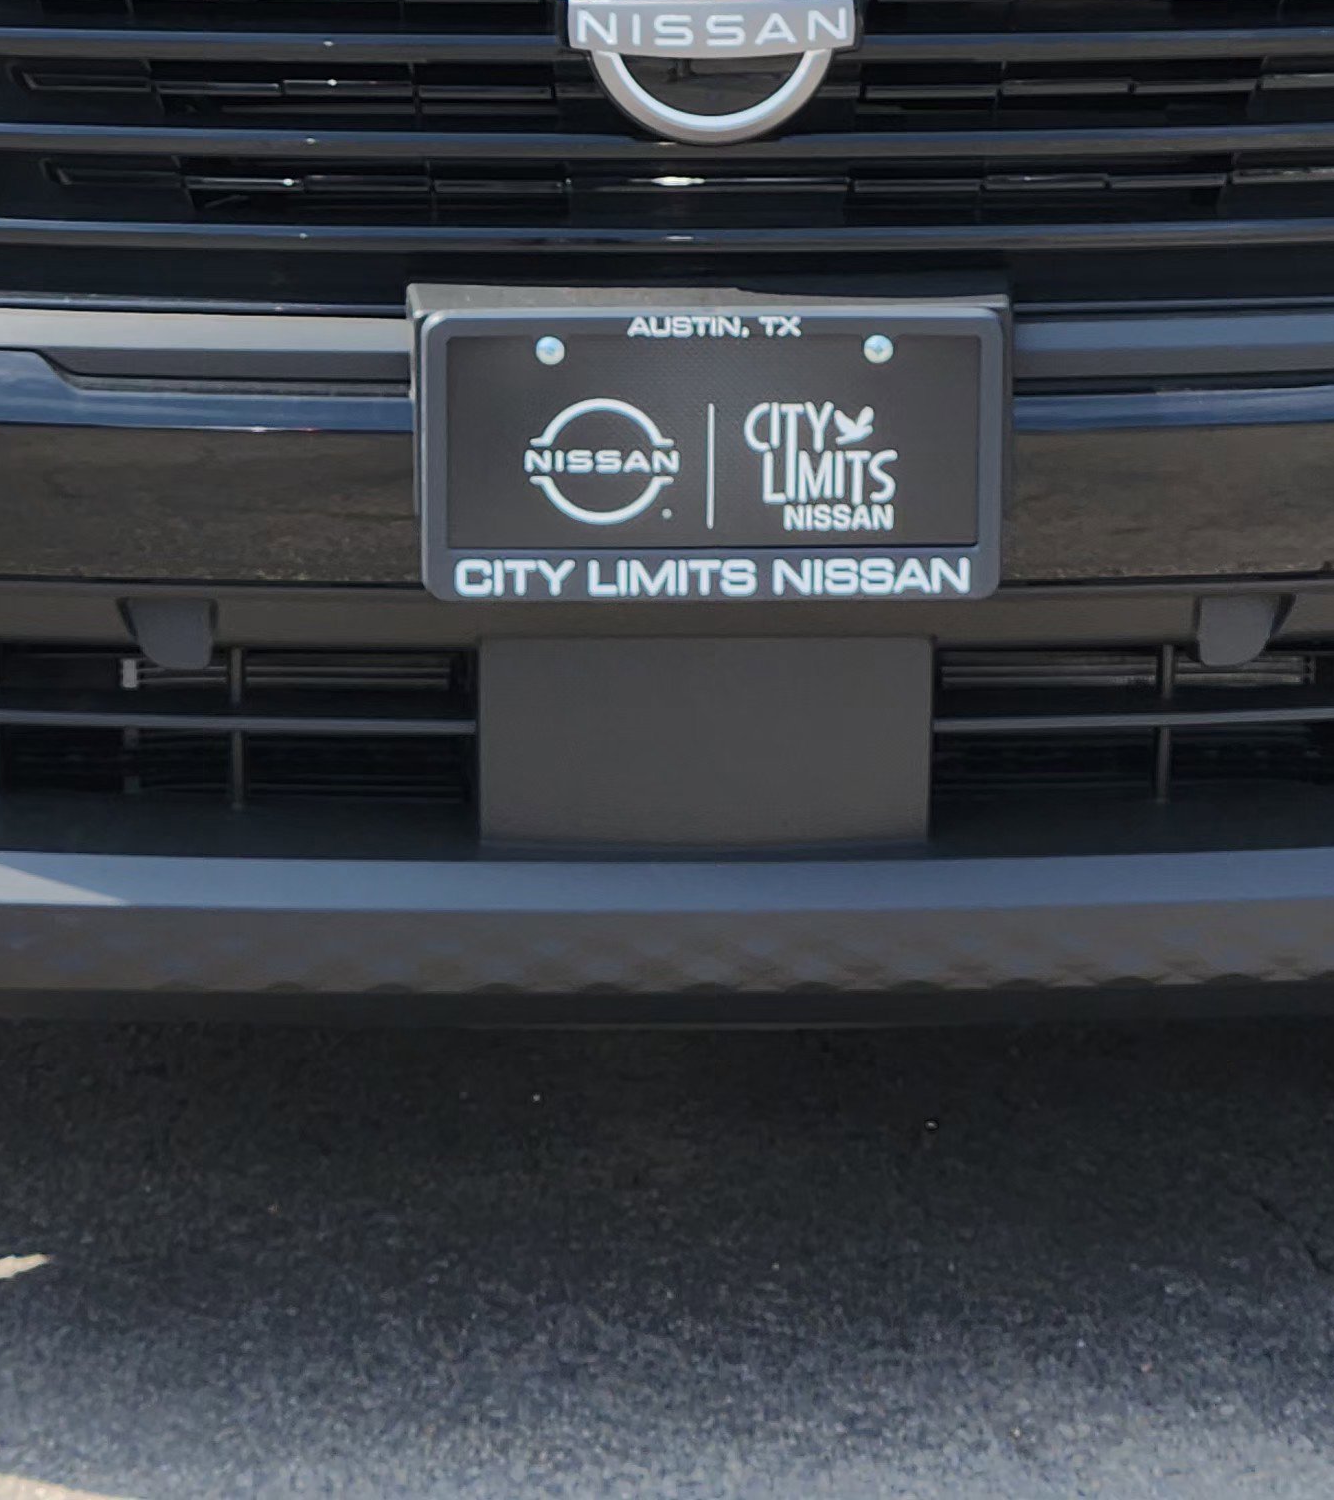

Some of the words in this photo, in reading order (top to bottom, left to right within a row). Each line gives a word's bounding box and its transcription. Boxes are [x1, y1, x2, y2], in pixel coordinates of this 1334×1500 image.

[576, 7, 848, 47] NISSAN
[627, 316, 750, 338] AUSTIN,
[758, 316, 801, 337] TX
[744, 401, 834, 452] CITY
[524, 448, 679, 474] NISSAN
[762, 450, 898, 504] LIMITS
[783, 504, 895, 531] NISSAN
[454, 558, 576, 597] CITY
[587, 558, 758, 596] LIMITS
[772, 556, 971, 595] NISSAN
